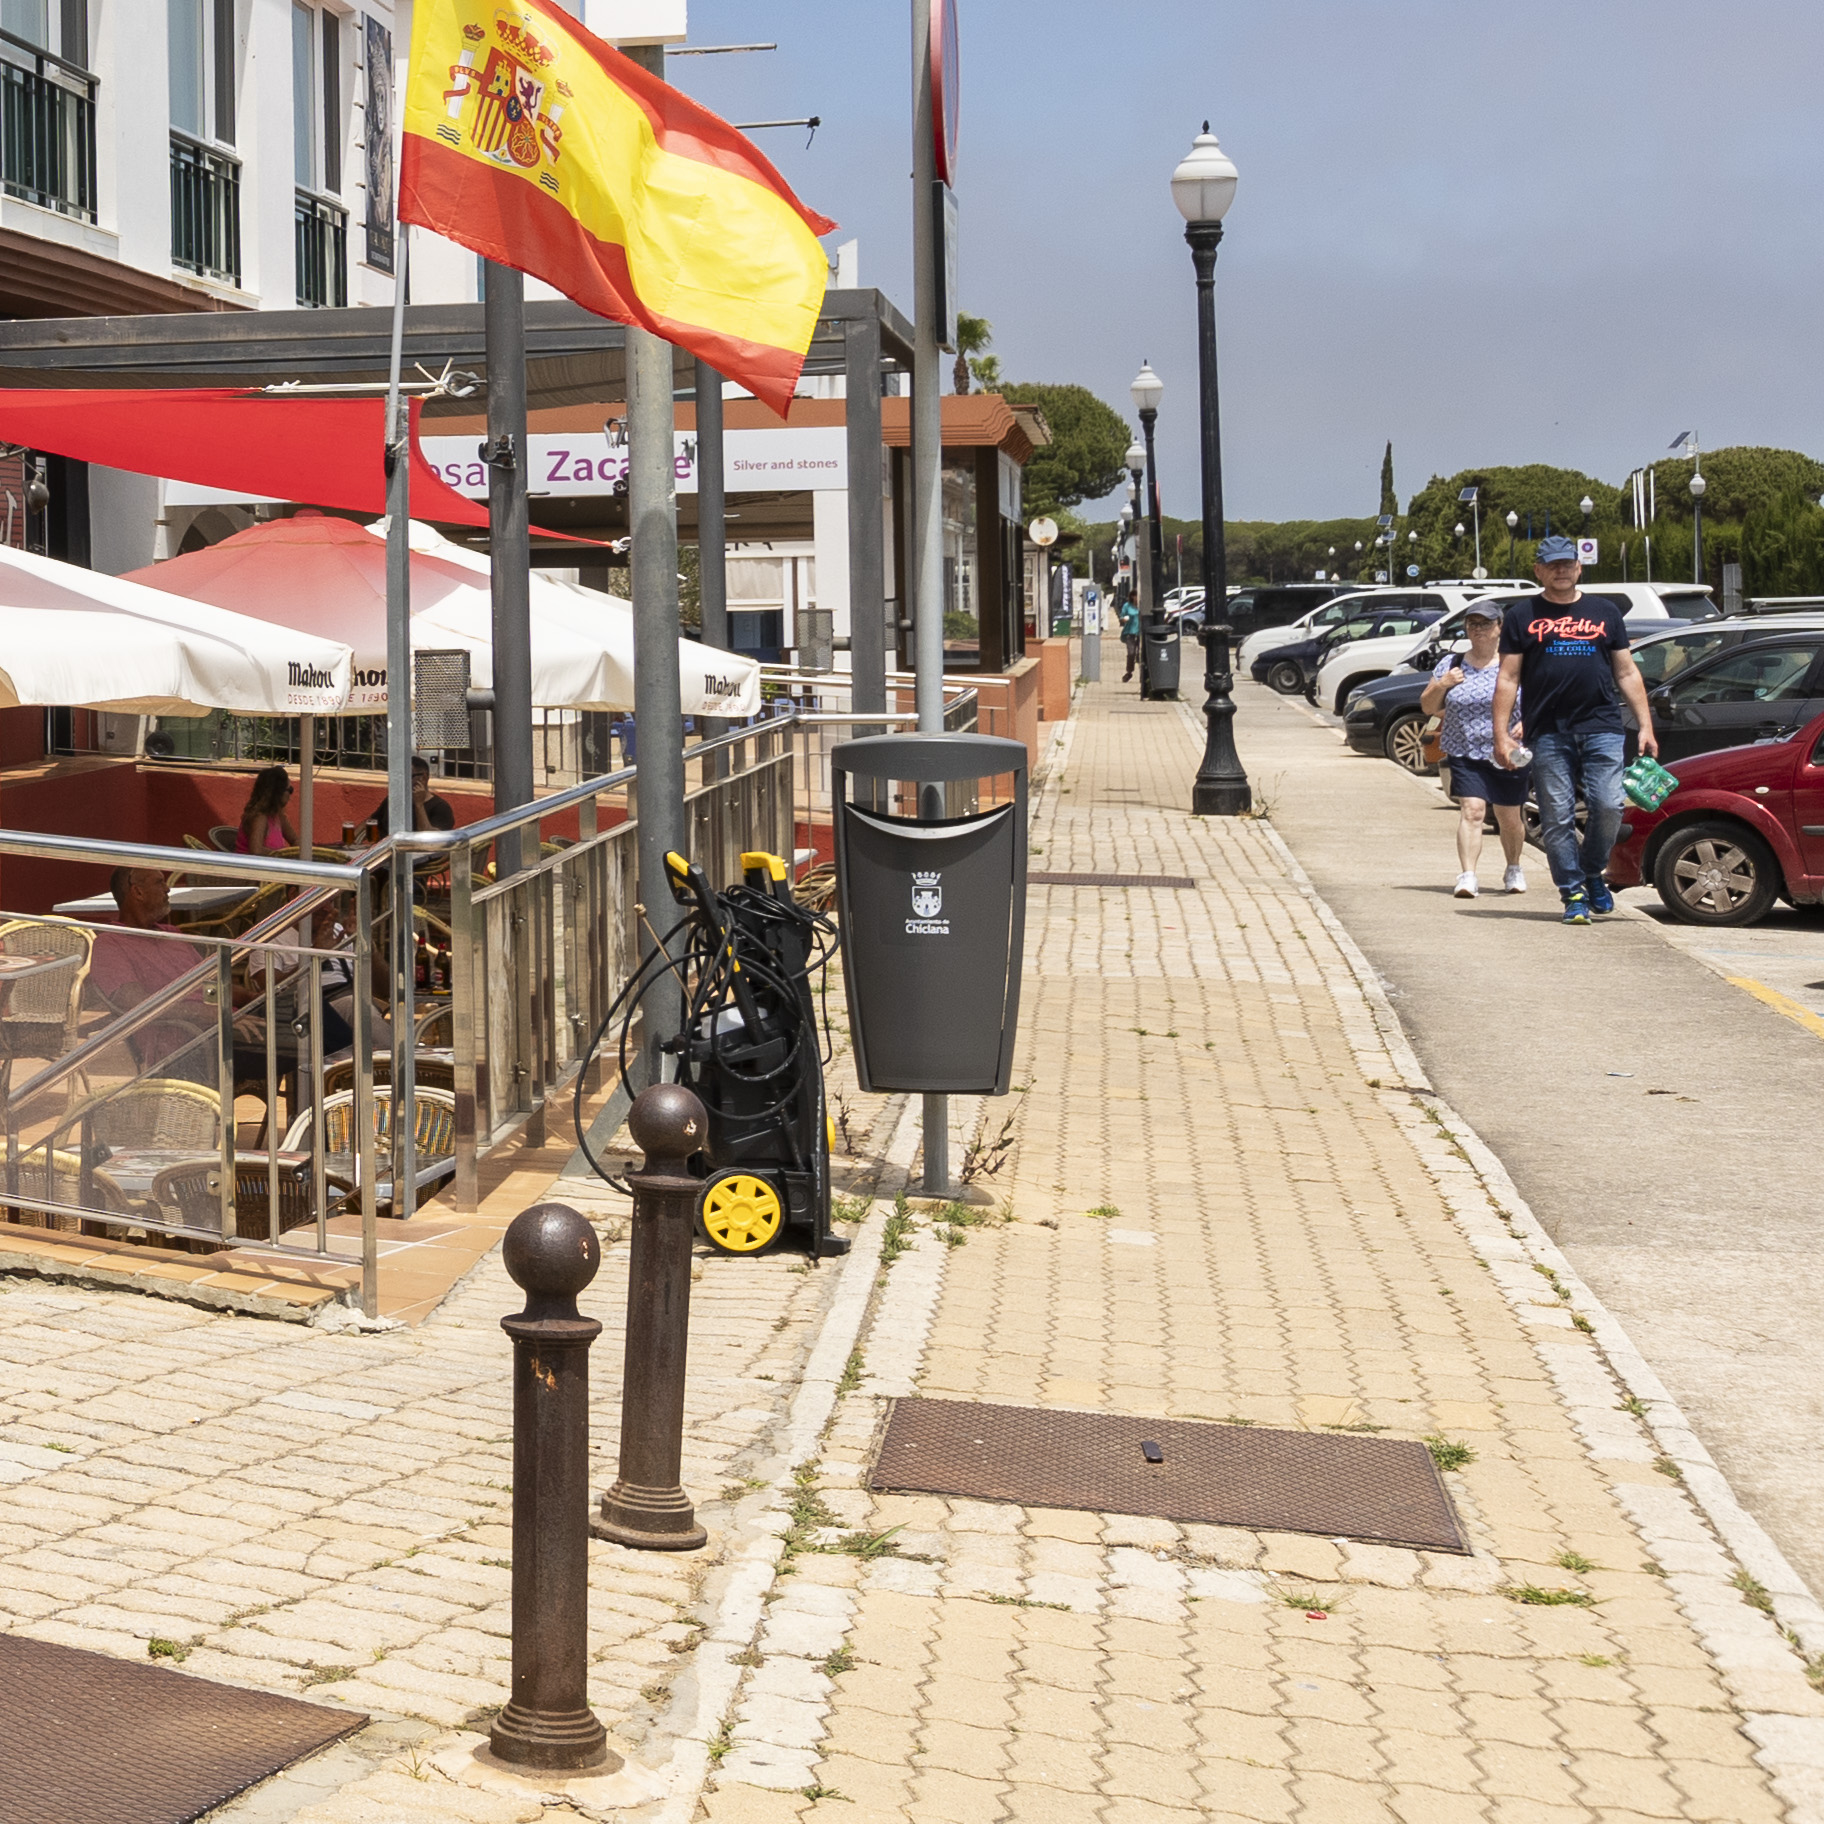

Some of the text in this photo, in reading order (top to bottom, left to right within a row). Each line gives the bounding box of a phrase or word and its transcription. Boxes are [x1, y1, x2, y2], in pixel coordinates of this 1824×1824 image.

[733, 458, 839, 471] Silver and stones
[287, 661, 335, 688] Mahou
[288, 693, 314, 706] DESDE
[318, 695, 342, 706] 1890
[905, 924, 950, 935] Chiclana
